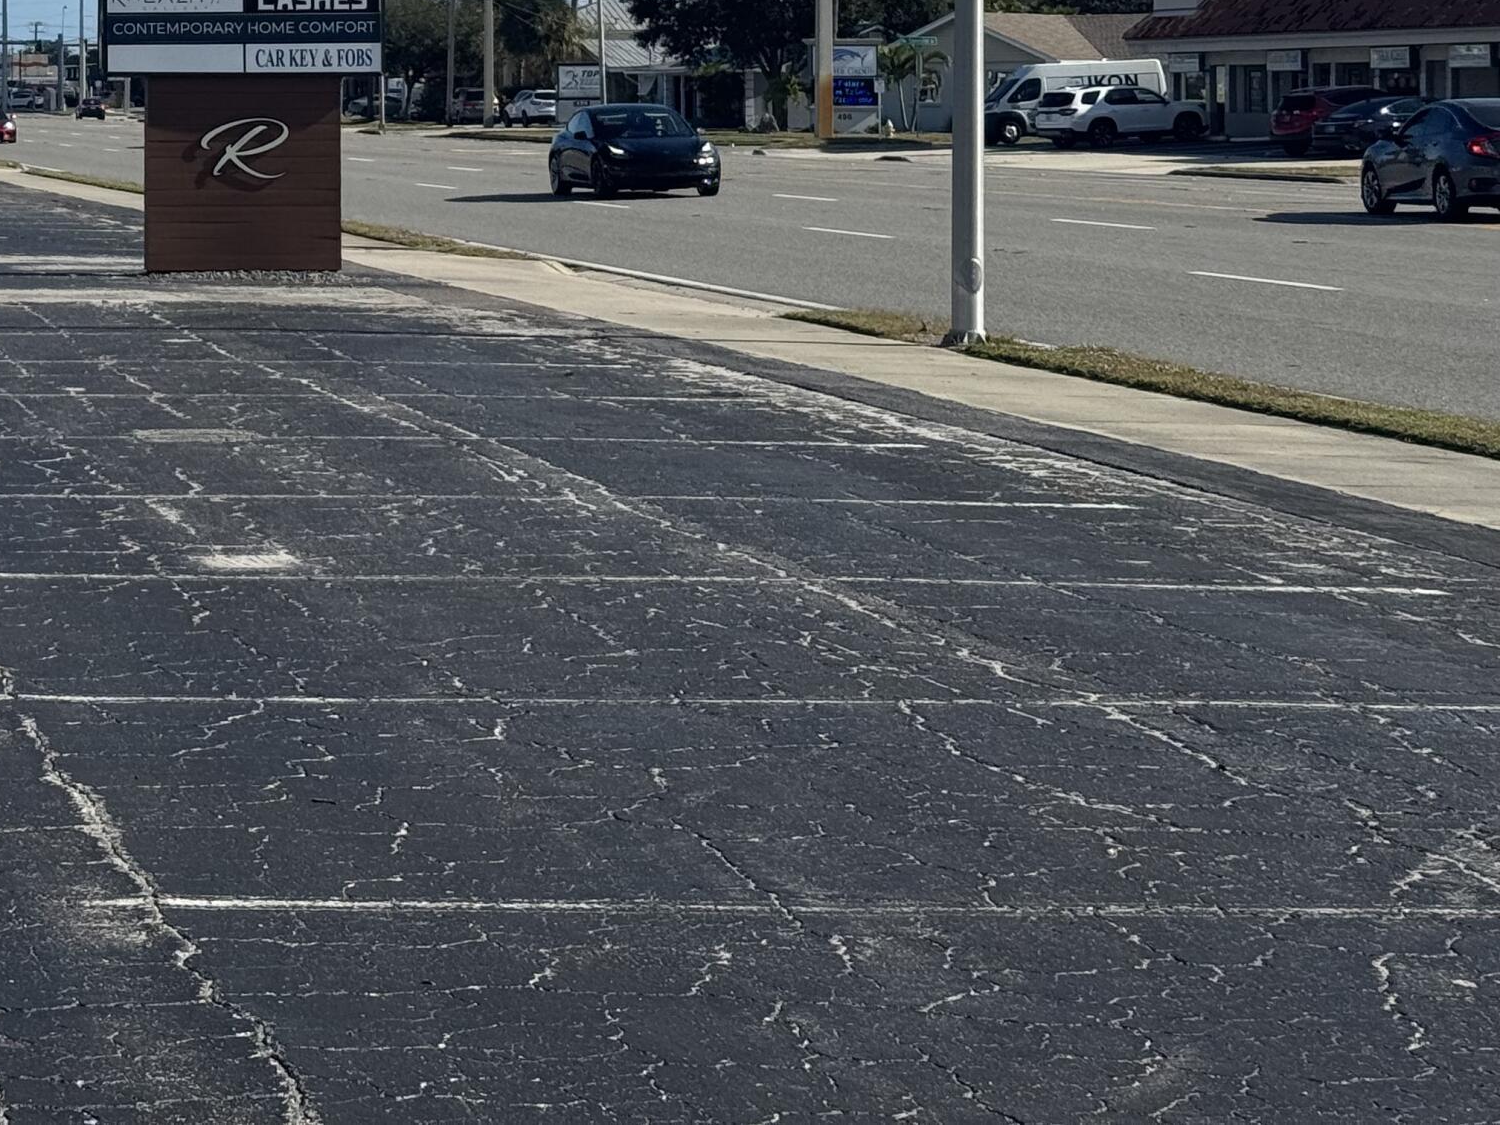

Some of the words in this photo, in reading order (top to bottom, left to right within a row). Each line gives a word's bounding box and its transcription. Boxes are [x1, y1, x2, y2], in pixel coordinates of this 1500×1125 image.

[112, 22, 244, 35] CONTEMPORARY
[247, 22, 295, 34] HOME
[298, 21, 376, 34] COMFORT
[255, 49, 285, 67] CAR
[289, 49, 318, 67] KEY
[321, 49, 333, 67] &
[337, 48, 373, 67] FOBS
[200, 117, 289, 179] R
